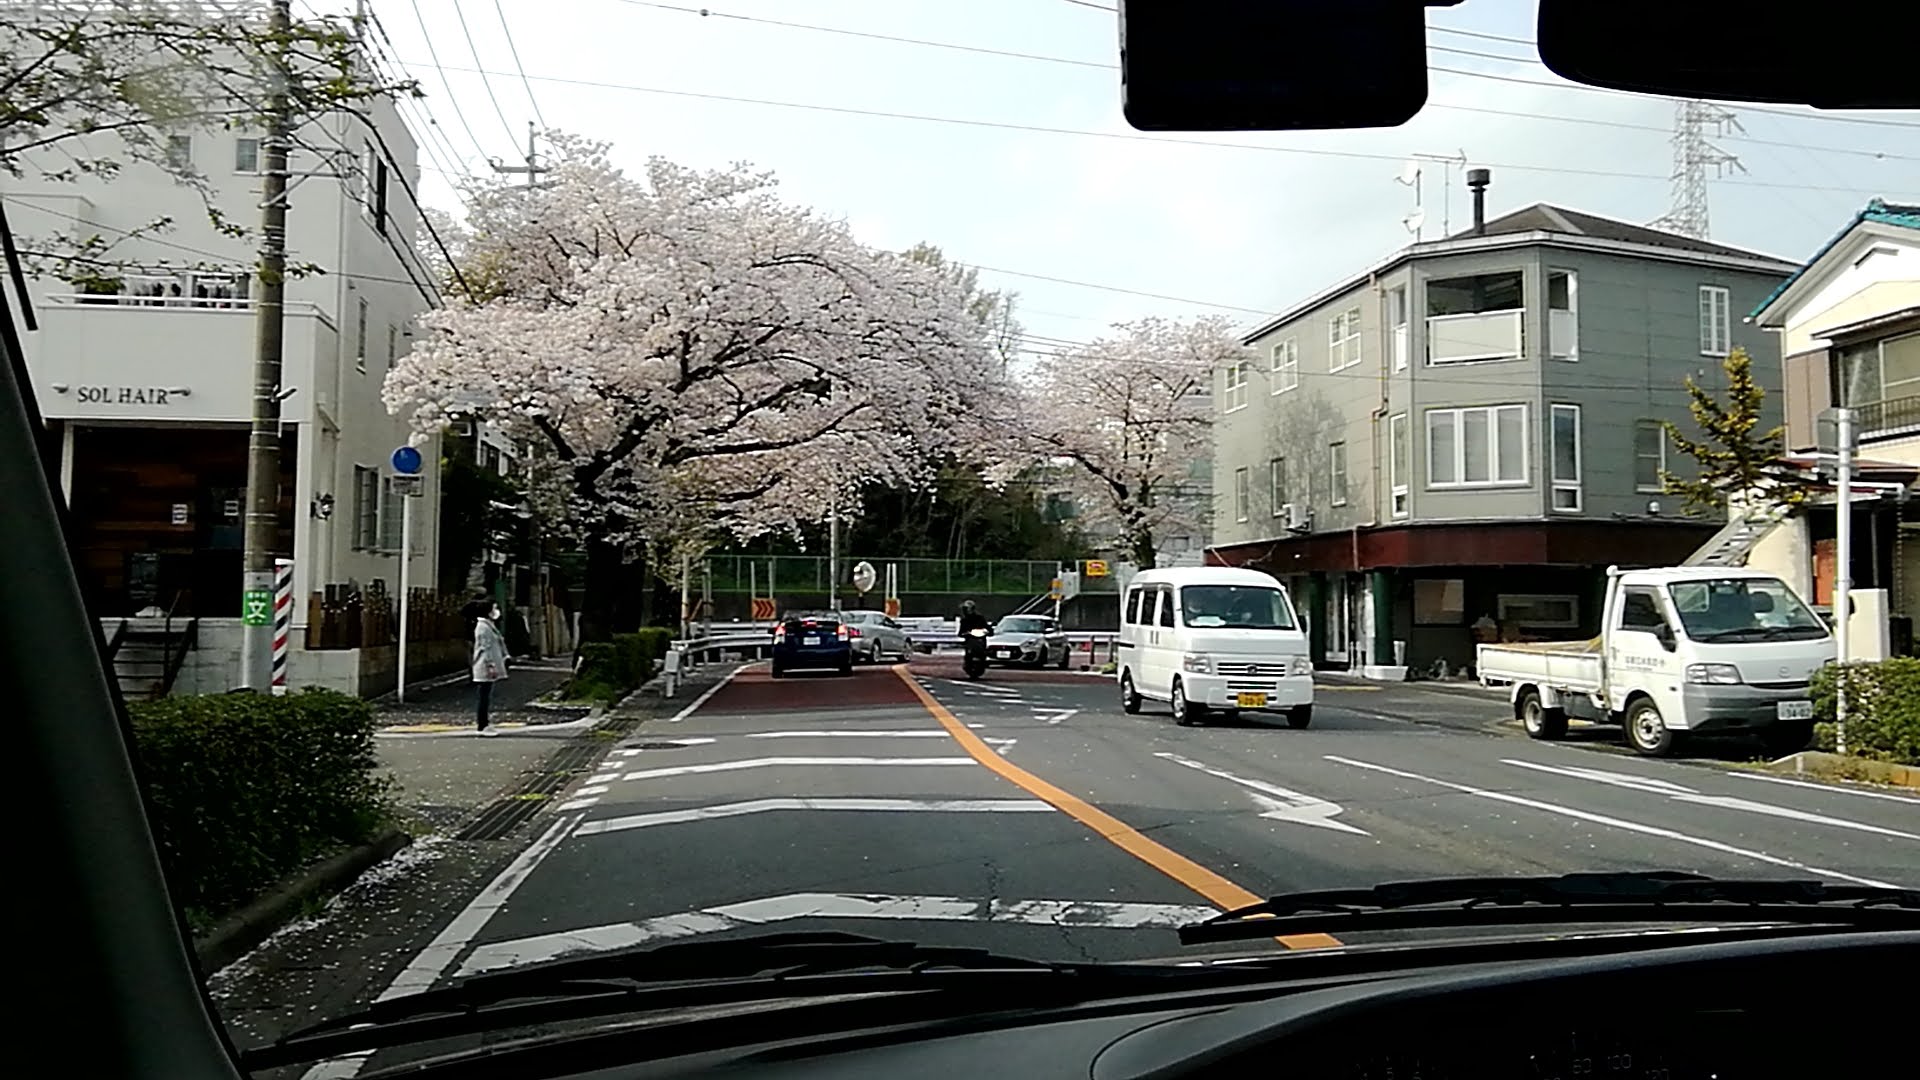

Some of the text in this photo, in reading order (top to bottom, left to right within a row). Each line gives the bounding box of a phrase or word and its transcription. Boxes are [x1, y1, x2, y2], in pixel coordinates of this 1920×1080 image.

[78, 387, 168, 404] SOL HAIR
[247, 600, 266, 619] 文
